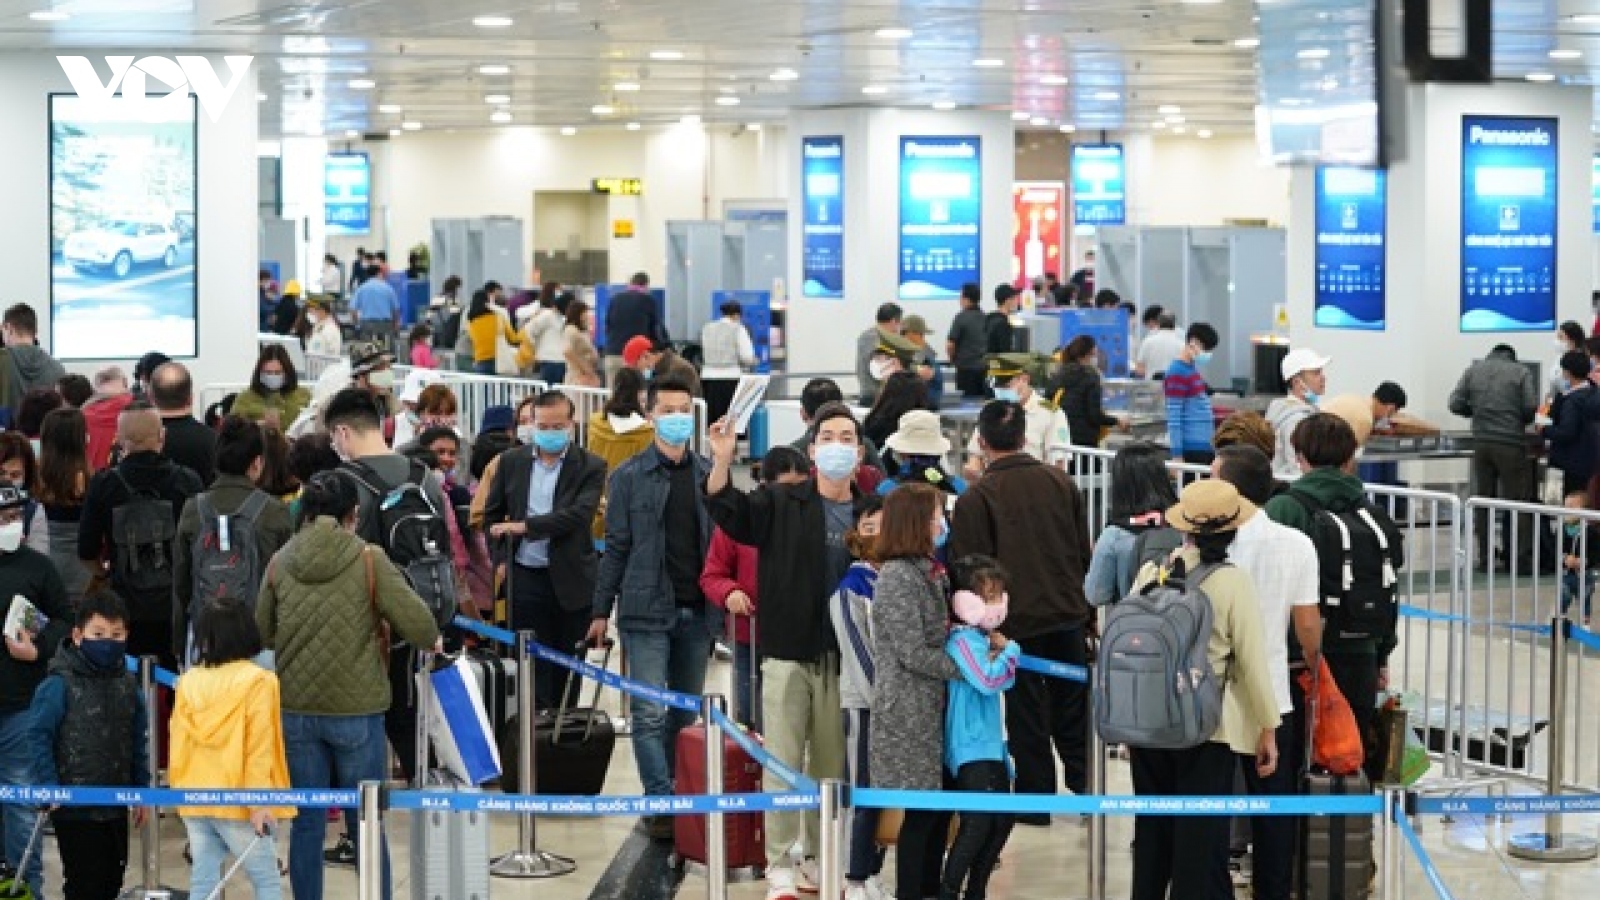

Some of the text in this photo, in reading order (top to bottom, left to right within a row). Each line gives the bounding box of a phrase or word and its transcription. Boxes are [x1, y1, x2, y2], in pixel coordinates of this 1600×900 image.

[1470, 125, 1551, 146] Panasonic
[224, 792, 308, 804] INTERNATIONAL
[311, 792, 356, 804] AIRPORT
